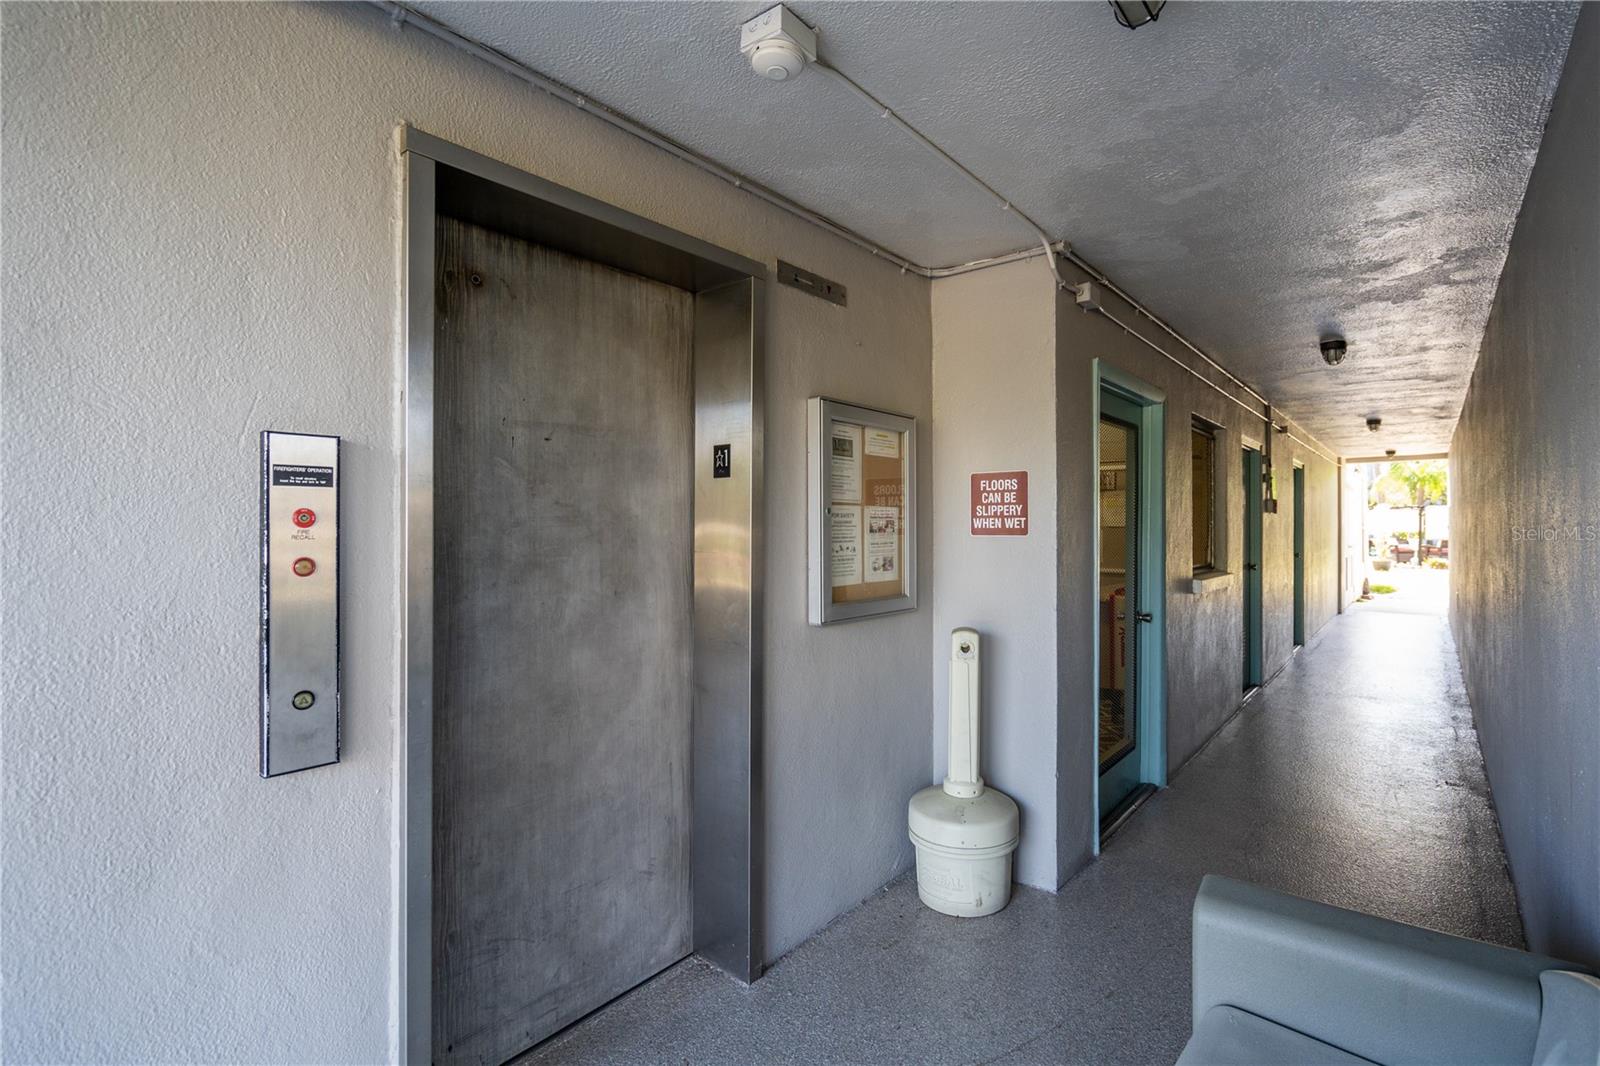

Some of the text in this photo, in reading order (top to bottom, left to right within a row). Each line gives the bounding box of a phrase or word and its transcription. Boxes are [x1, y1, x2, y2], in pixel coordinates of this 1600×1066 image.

[724, 449, 728, 467] 1
[980, 479, 1018, 491] FLOORS
[982, 492, 1017, 503] CAN BE
[976, 505, 1023, 516] SLIPPERY
[973, 517, 1026, 529] WHEN WET
